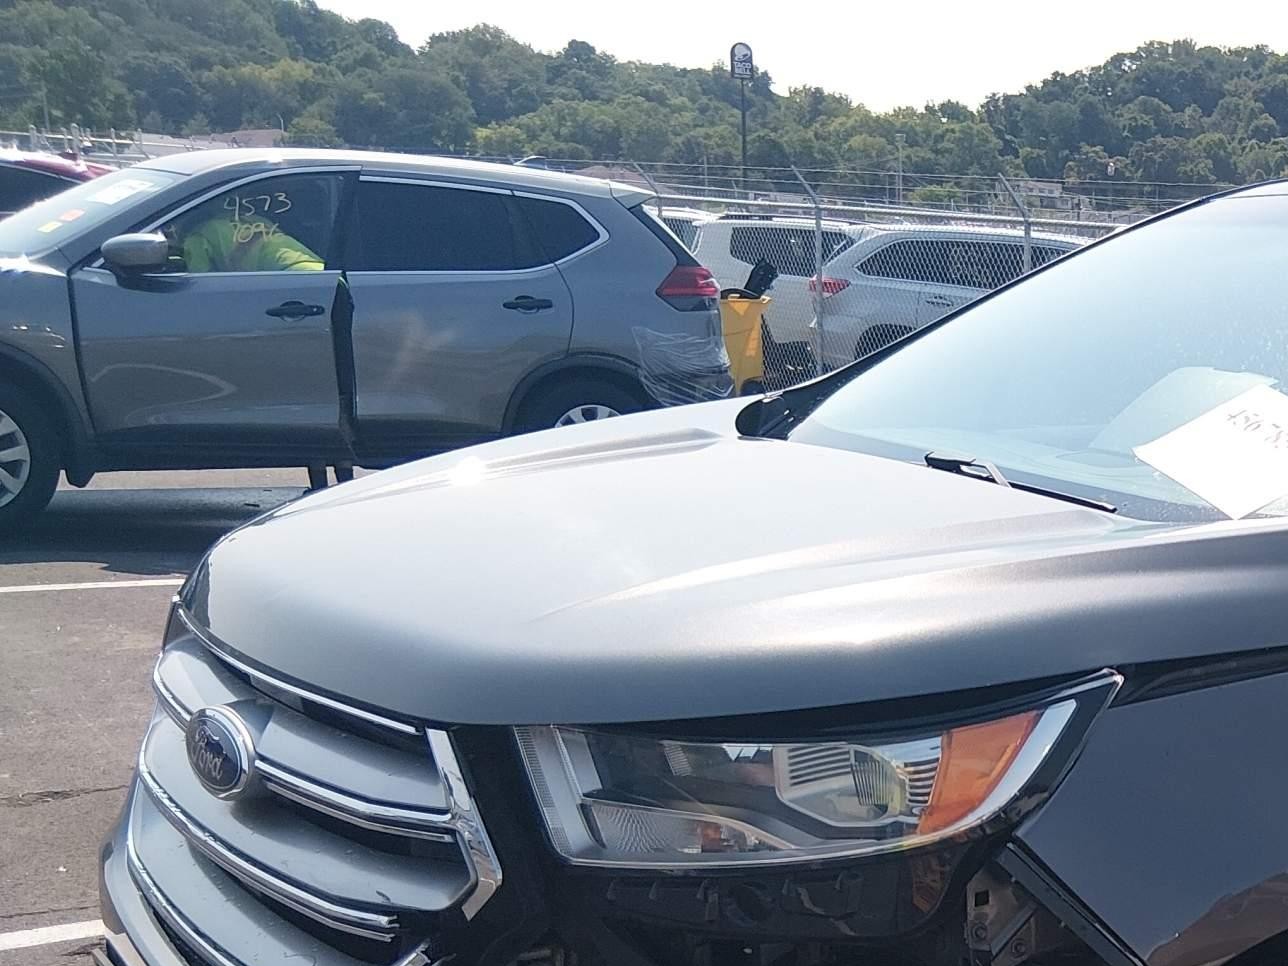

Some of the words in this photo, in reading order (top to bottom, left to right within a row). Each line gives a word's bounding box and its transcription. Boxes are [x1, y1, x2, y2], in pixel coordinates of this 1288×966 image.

[733, 61, 752, 69] TACO
[734, 67, 752, 75] BELL
[223, 192, 292, 222] 4573
[190, 725, 224, 781] Ford
